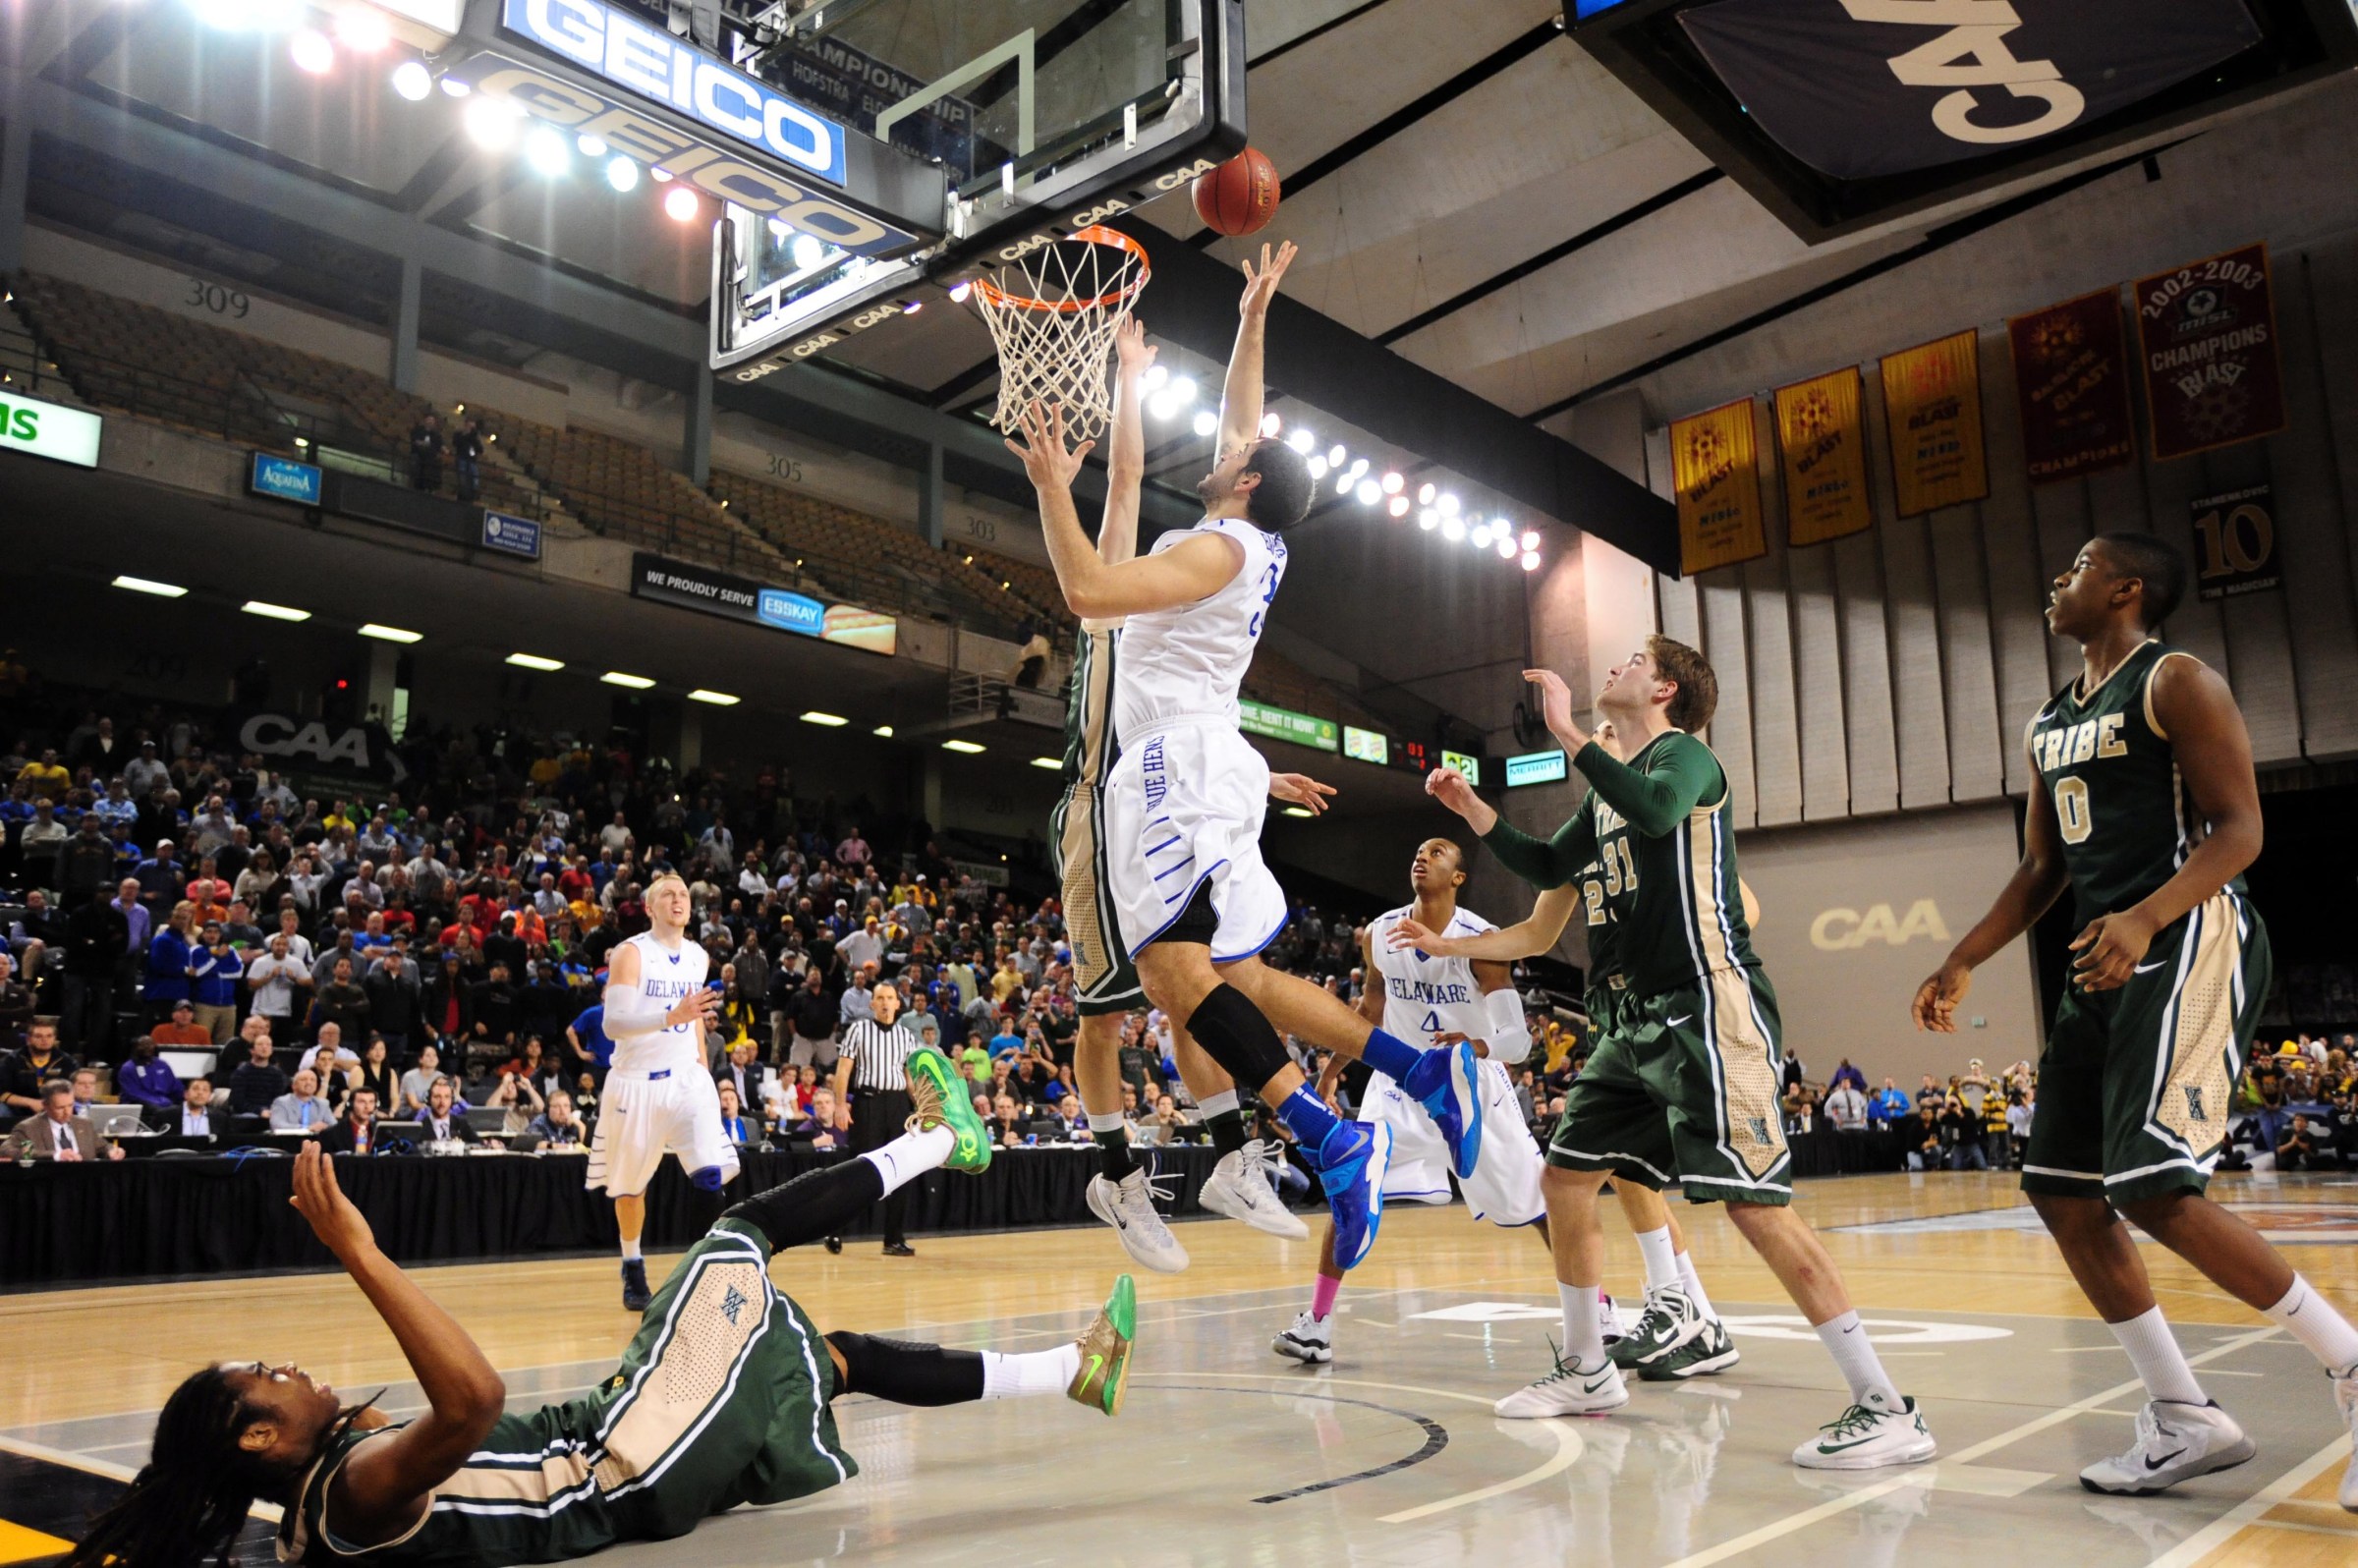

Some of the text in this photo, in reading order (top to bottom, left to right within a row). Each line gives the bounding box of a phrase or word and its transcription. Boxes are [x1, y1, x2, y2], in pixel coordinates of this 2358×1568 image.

[526, 0, 832, 172] GEICO
[478, 69, 886, 247] GEICO
[1155, 159, 1217, 192] CAA
[1072, 198, 1129, 227] CAA
[1000, 235, 1053, 262] CAA
[185, 279, 250, 319] 309
[2142, 260, 2265, 319] 2002-2003
[854, 305, 900, 329] CAA
[793, 334, 839, 358] CAA
[2151, 323, 2268, 372] CHAMPIONS
[736, 363, 780, 383] CAA
[2176, 362, 2247, 399] BLAST
[765, 453, 803, 483] 305
[965, 516, 996, 543] 303
[2194, 504, 2274, 580] 10
[646, 570, 818, 623] WE PROUDLY SERVE ESSKAY
[240, 713, 370, 769] CAA
[1144, 735, 1166, 774] HENS
[2032, 712, 2129, 774] TRIBE
[2054, 775, 2093, 845] 0
[1602, 836, 1638, 897] 31
[1810, 898, 1951, 951] CAA
